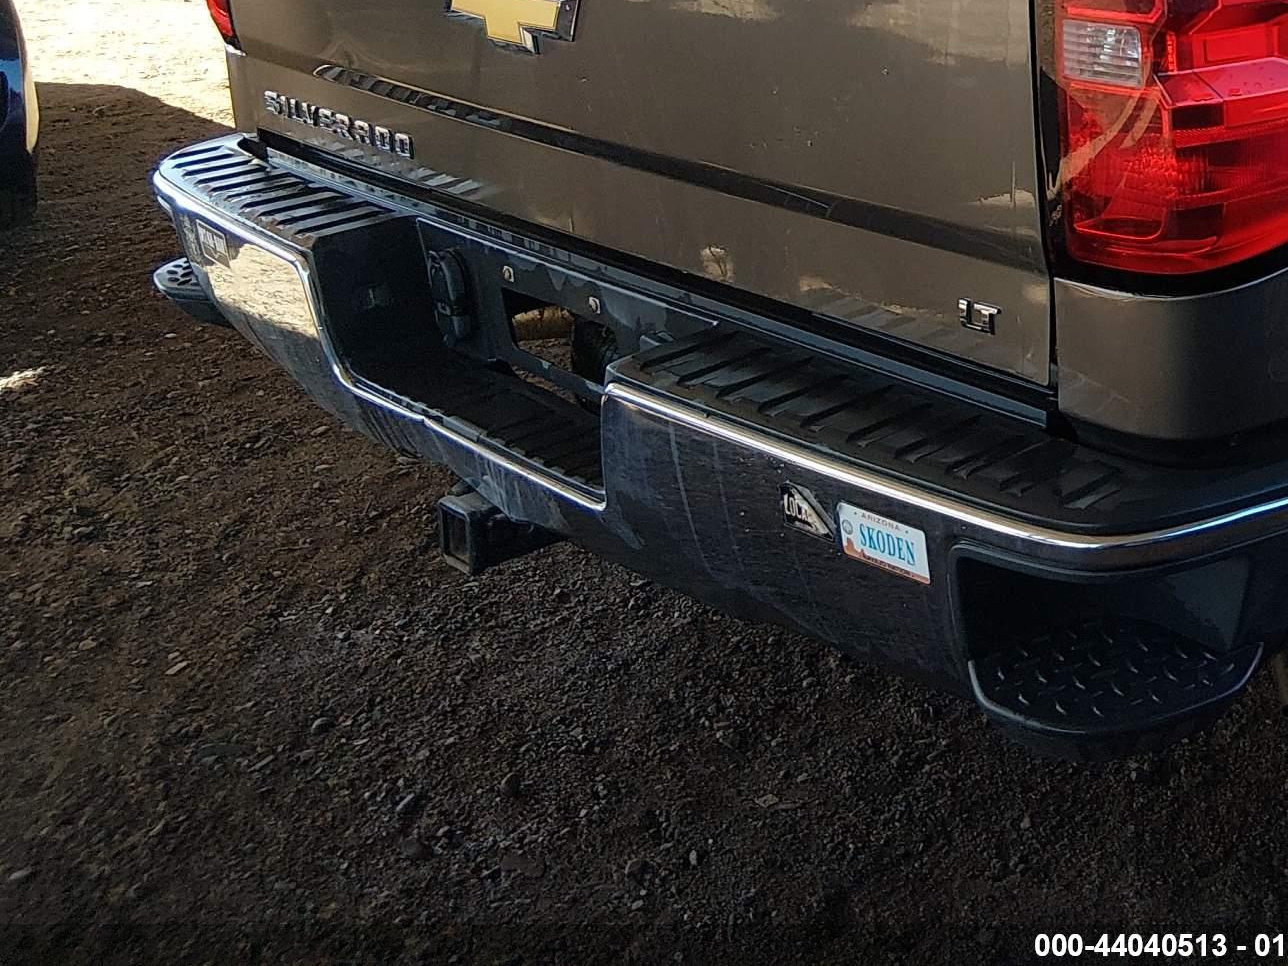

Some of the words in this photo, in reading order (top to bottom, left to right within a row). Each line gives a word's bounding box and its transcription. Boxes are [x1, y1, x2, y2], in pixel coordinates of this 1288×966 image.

[263, 90, 414, 159] SILVERADO
[957, 297, 1001, 335] LT
[859, 523, 915, 566] SKODEN
